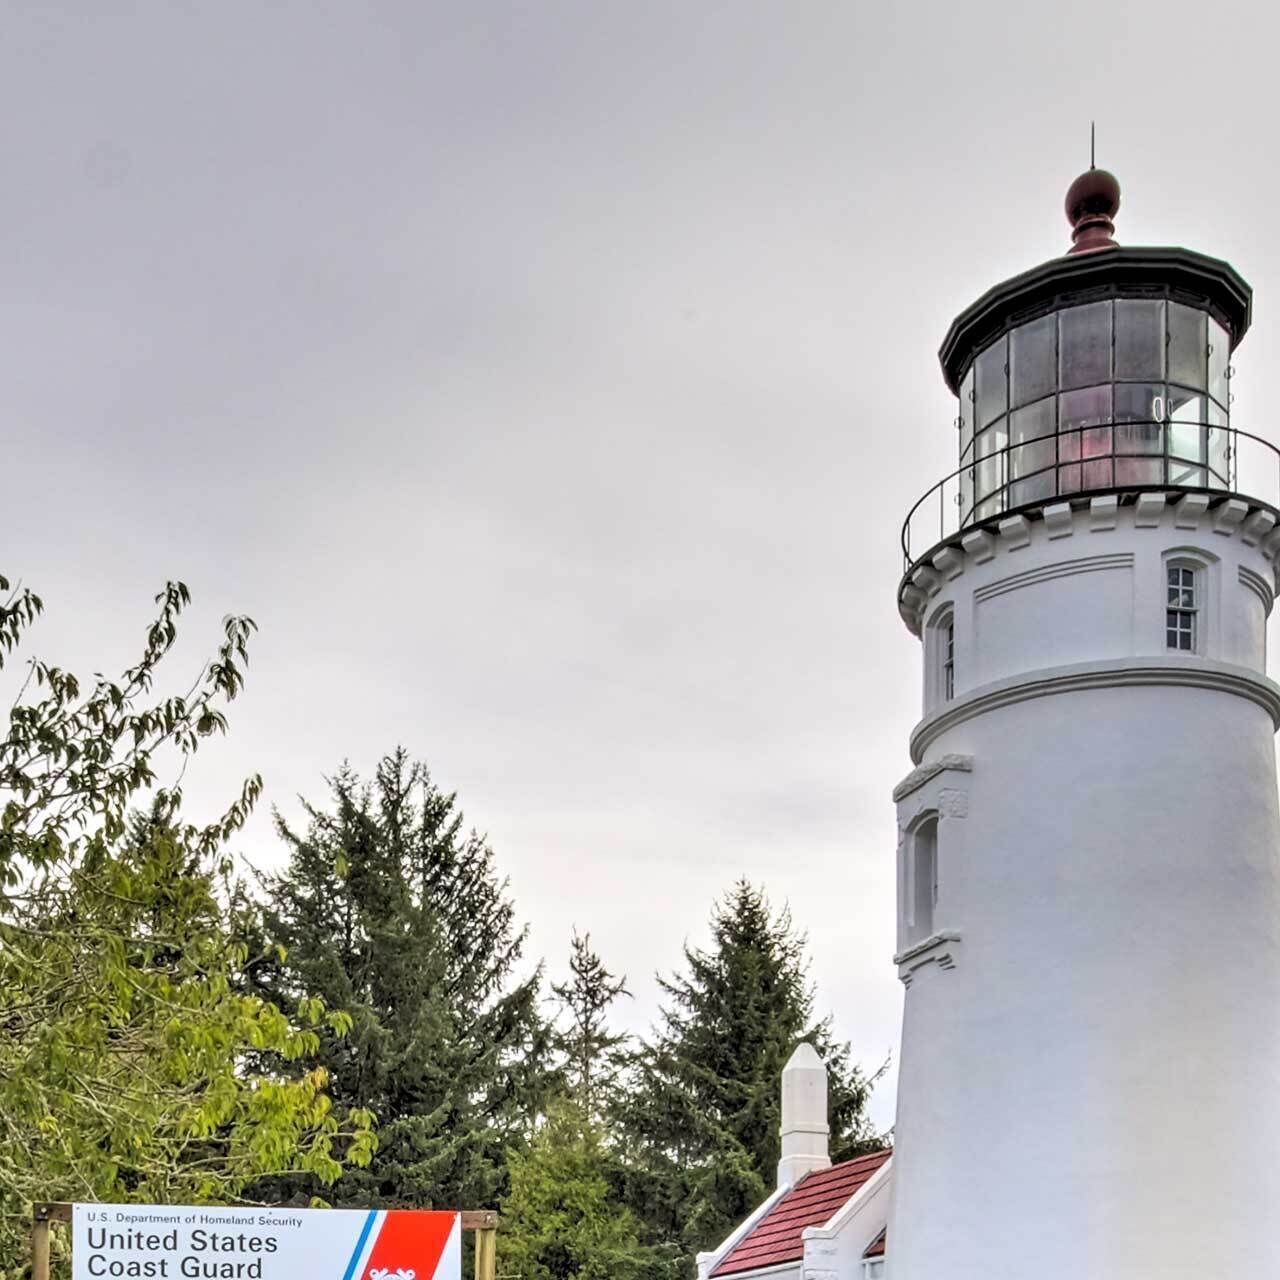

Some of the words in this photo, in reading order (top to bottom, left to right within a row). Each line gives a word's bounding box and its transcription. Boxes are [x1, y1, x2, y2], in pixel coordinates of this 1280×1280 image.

[87, 1212, 111, 1222] U.S.
[116, 1213, 180, 1225] Department
[185, 1215, 196, 1224] of
[200, 1216, 255, 1226] Homeland
[258, 1216, 303, 1228] Security
[87, 1228, 178, 1251] United
[190, 1230, 278, 1253] States
[87, 1254, 169, 1278] Coast
[181, 1256, 262, 1280] Guard
